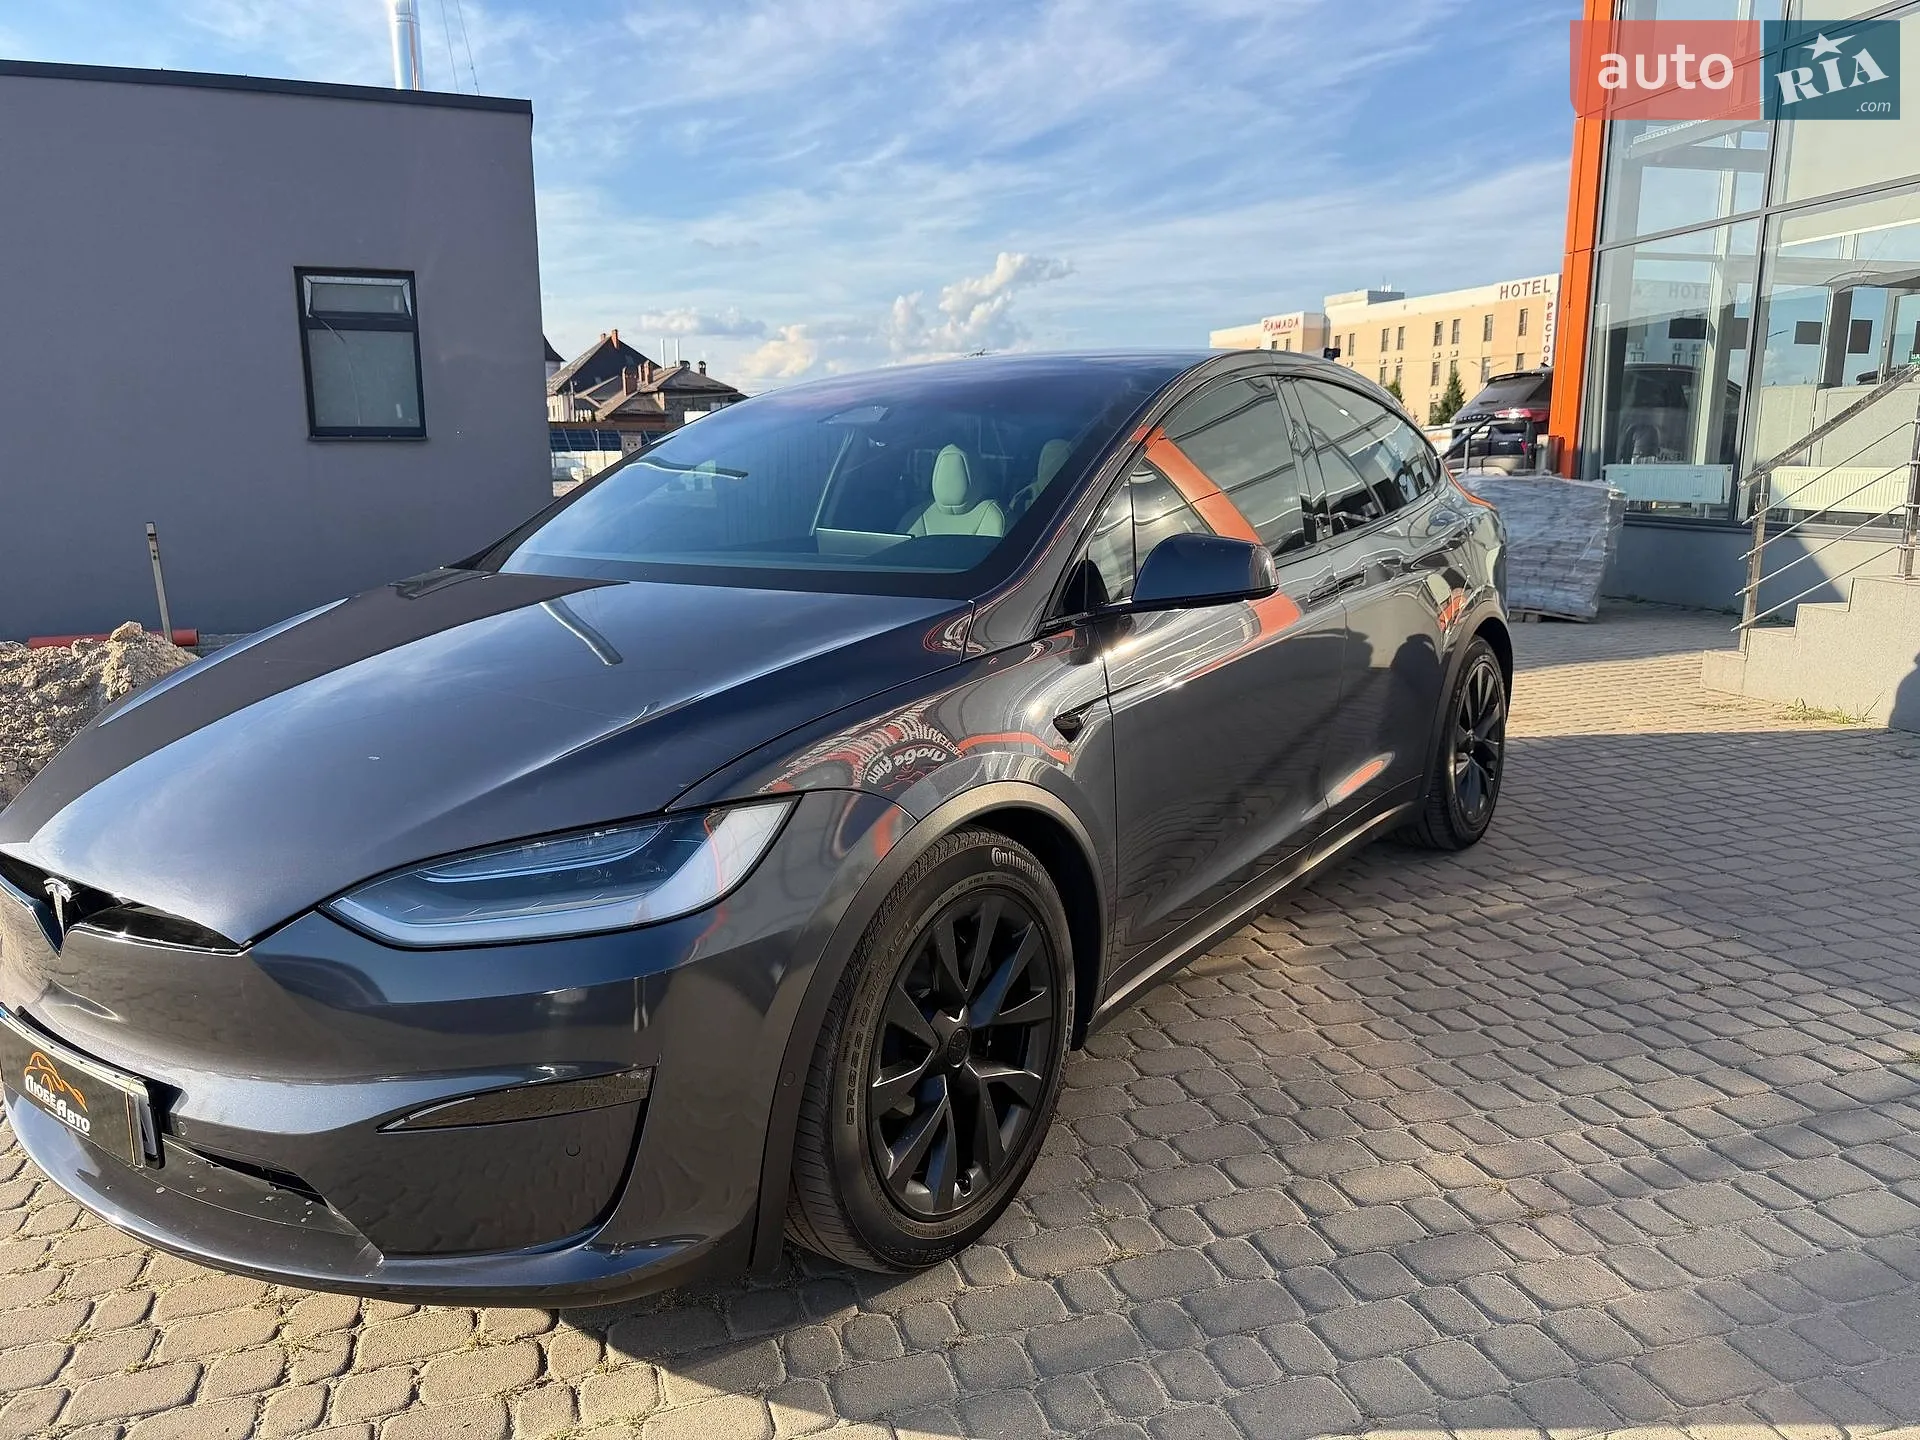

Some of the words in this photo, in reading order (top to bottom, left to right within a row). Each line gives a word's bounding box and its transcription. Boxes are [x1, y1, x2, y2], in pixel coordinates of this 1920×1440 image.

[1499, 278, 1551, 300] HOTEL
[1263, 316, 1299, 333] RAMADA
[991, 846, 1042, 885] Continental
